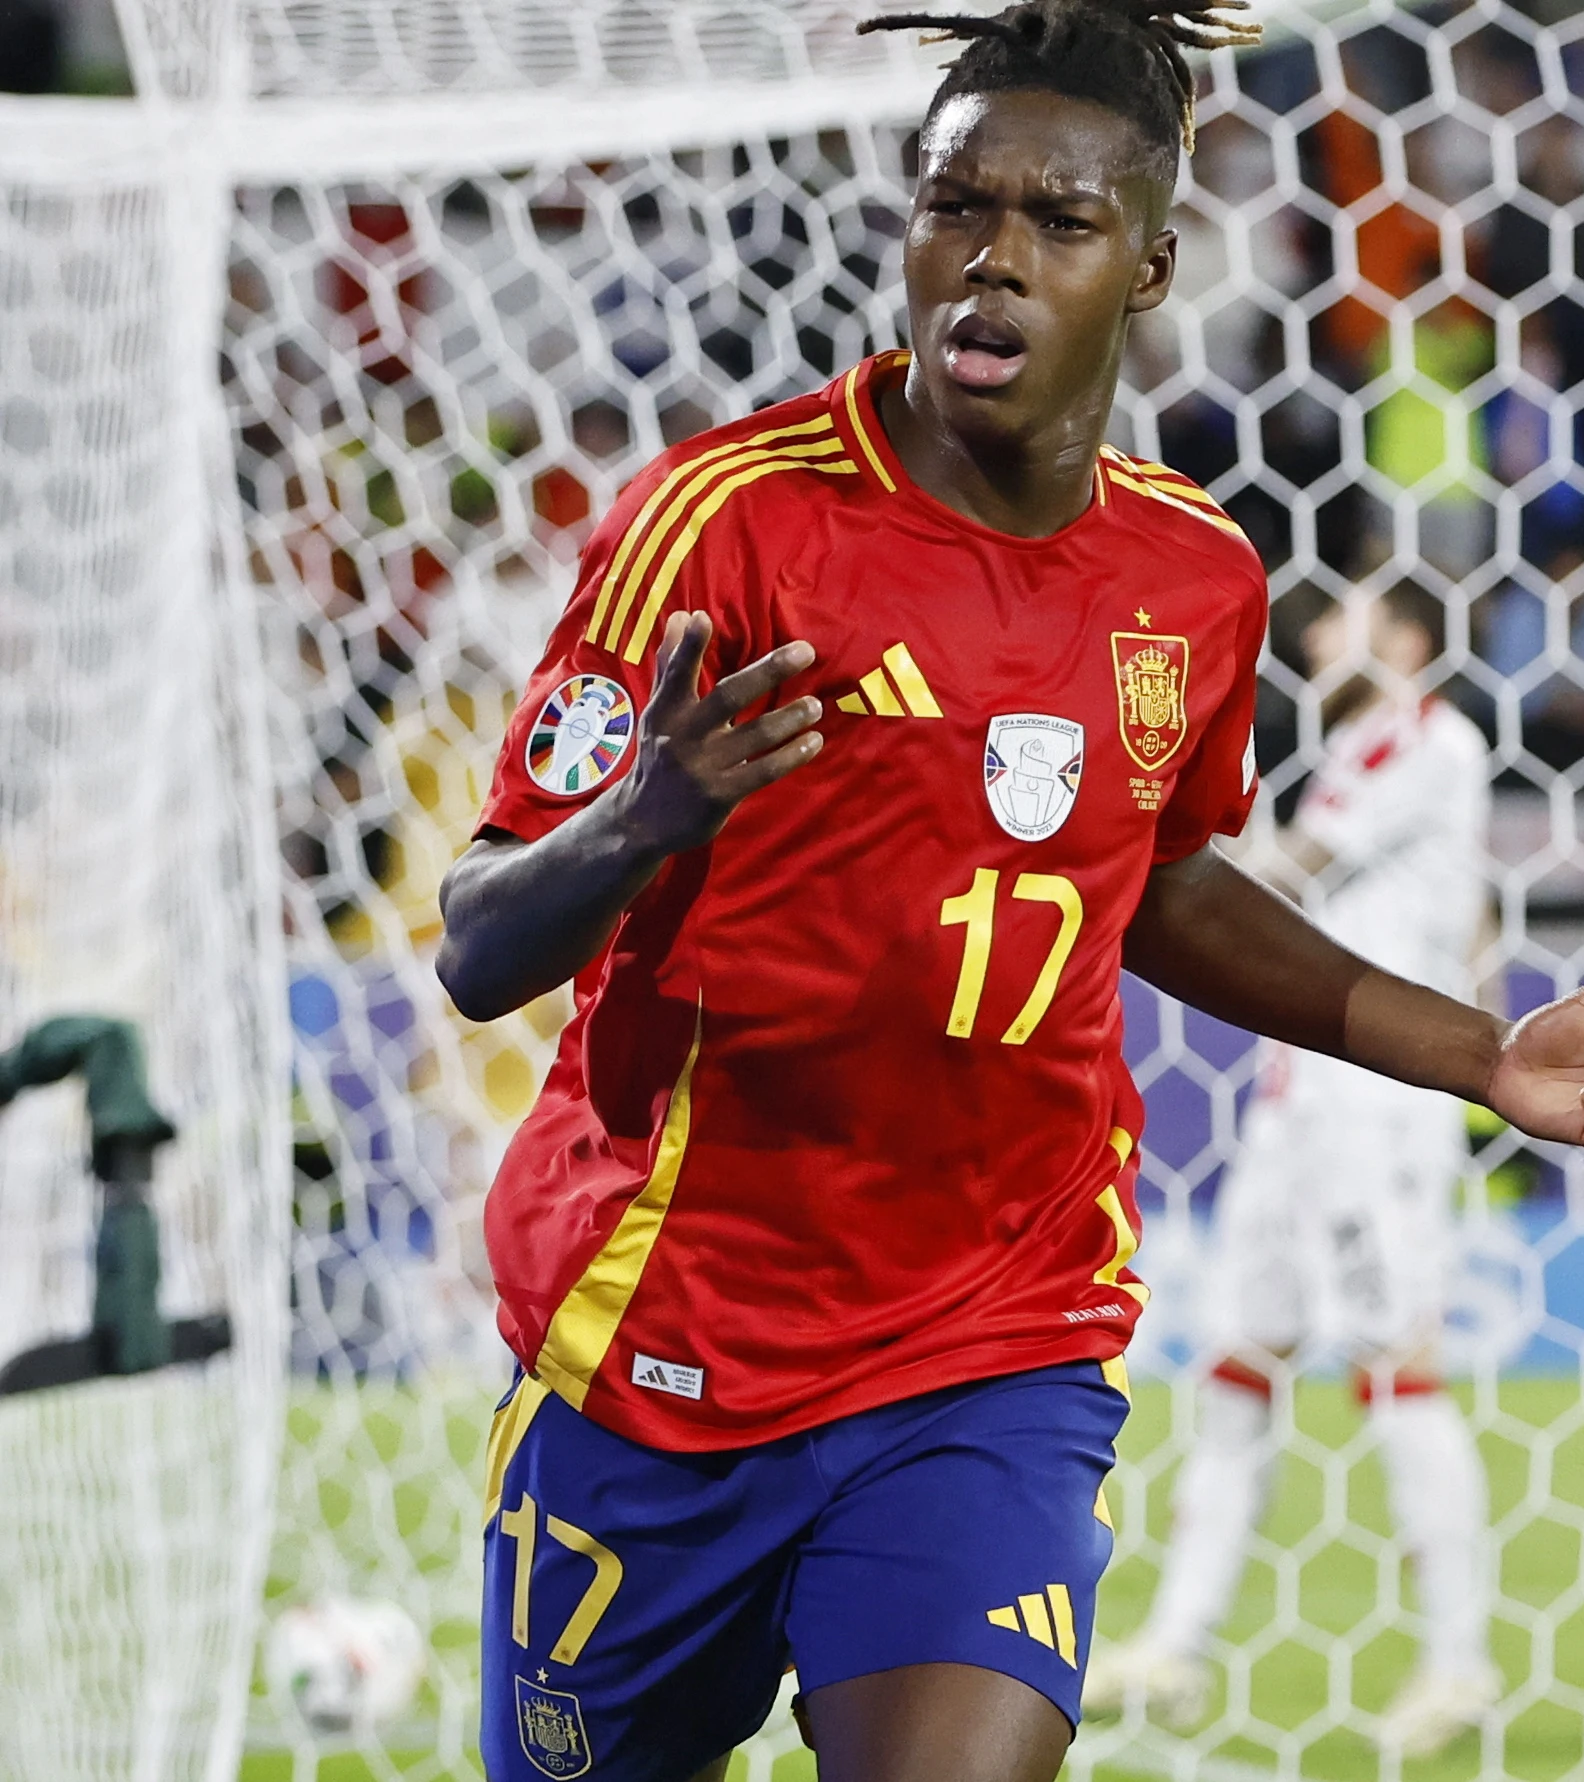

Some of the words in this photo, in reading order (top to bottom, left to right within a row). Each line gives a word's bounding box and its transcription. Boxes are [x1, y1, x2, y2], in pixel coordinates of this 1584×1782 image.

[995, 719, 1014, 728] UEFA
[1017, 718, 1050, 726] NATIONS
[1052, 721, 1079, 734] LEAGUE
[1005, 819, 1034, 835] WINNER
[940, 867, 1083, 1045] 17
[501, 1491, 623, 1666] 17
